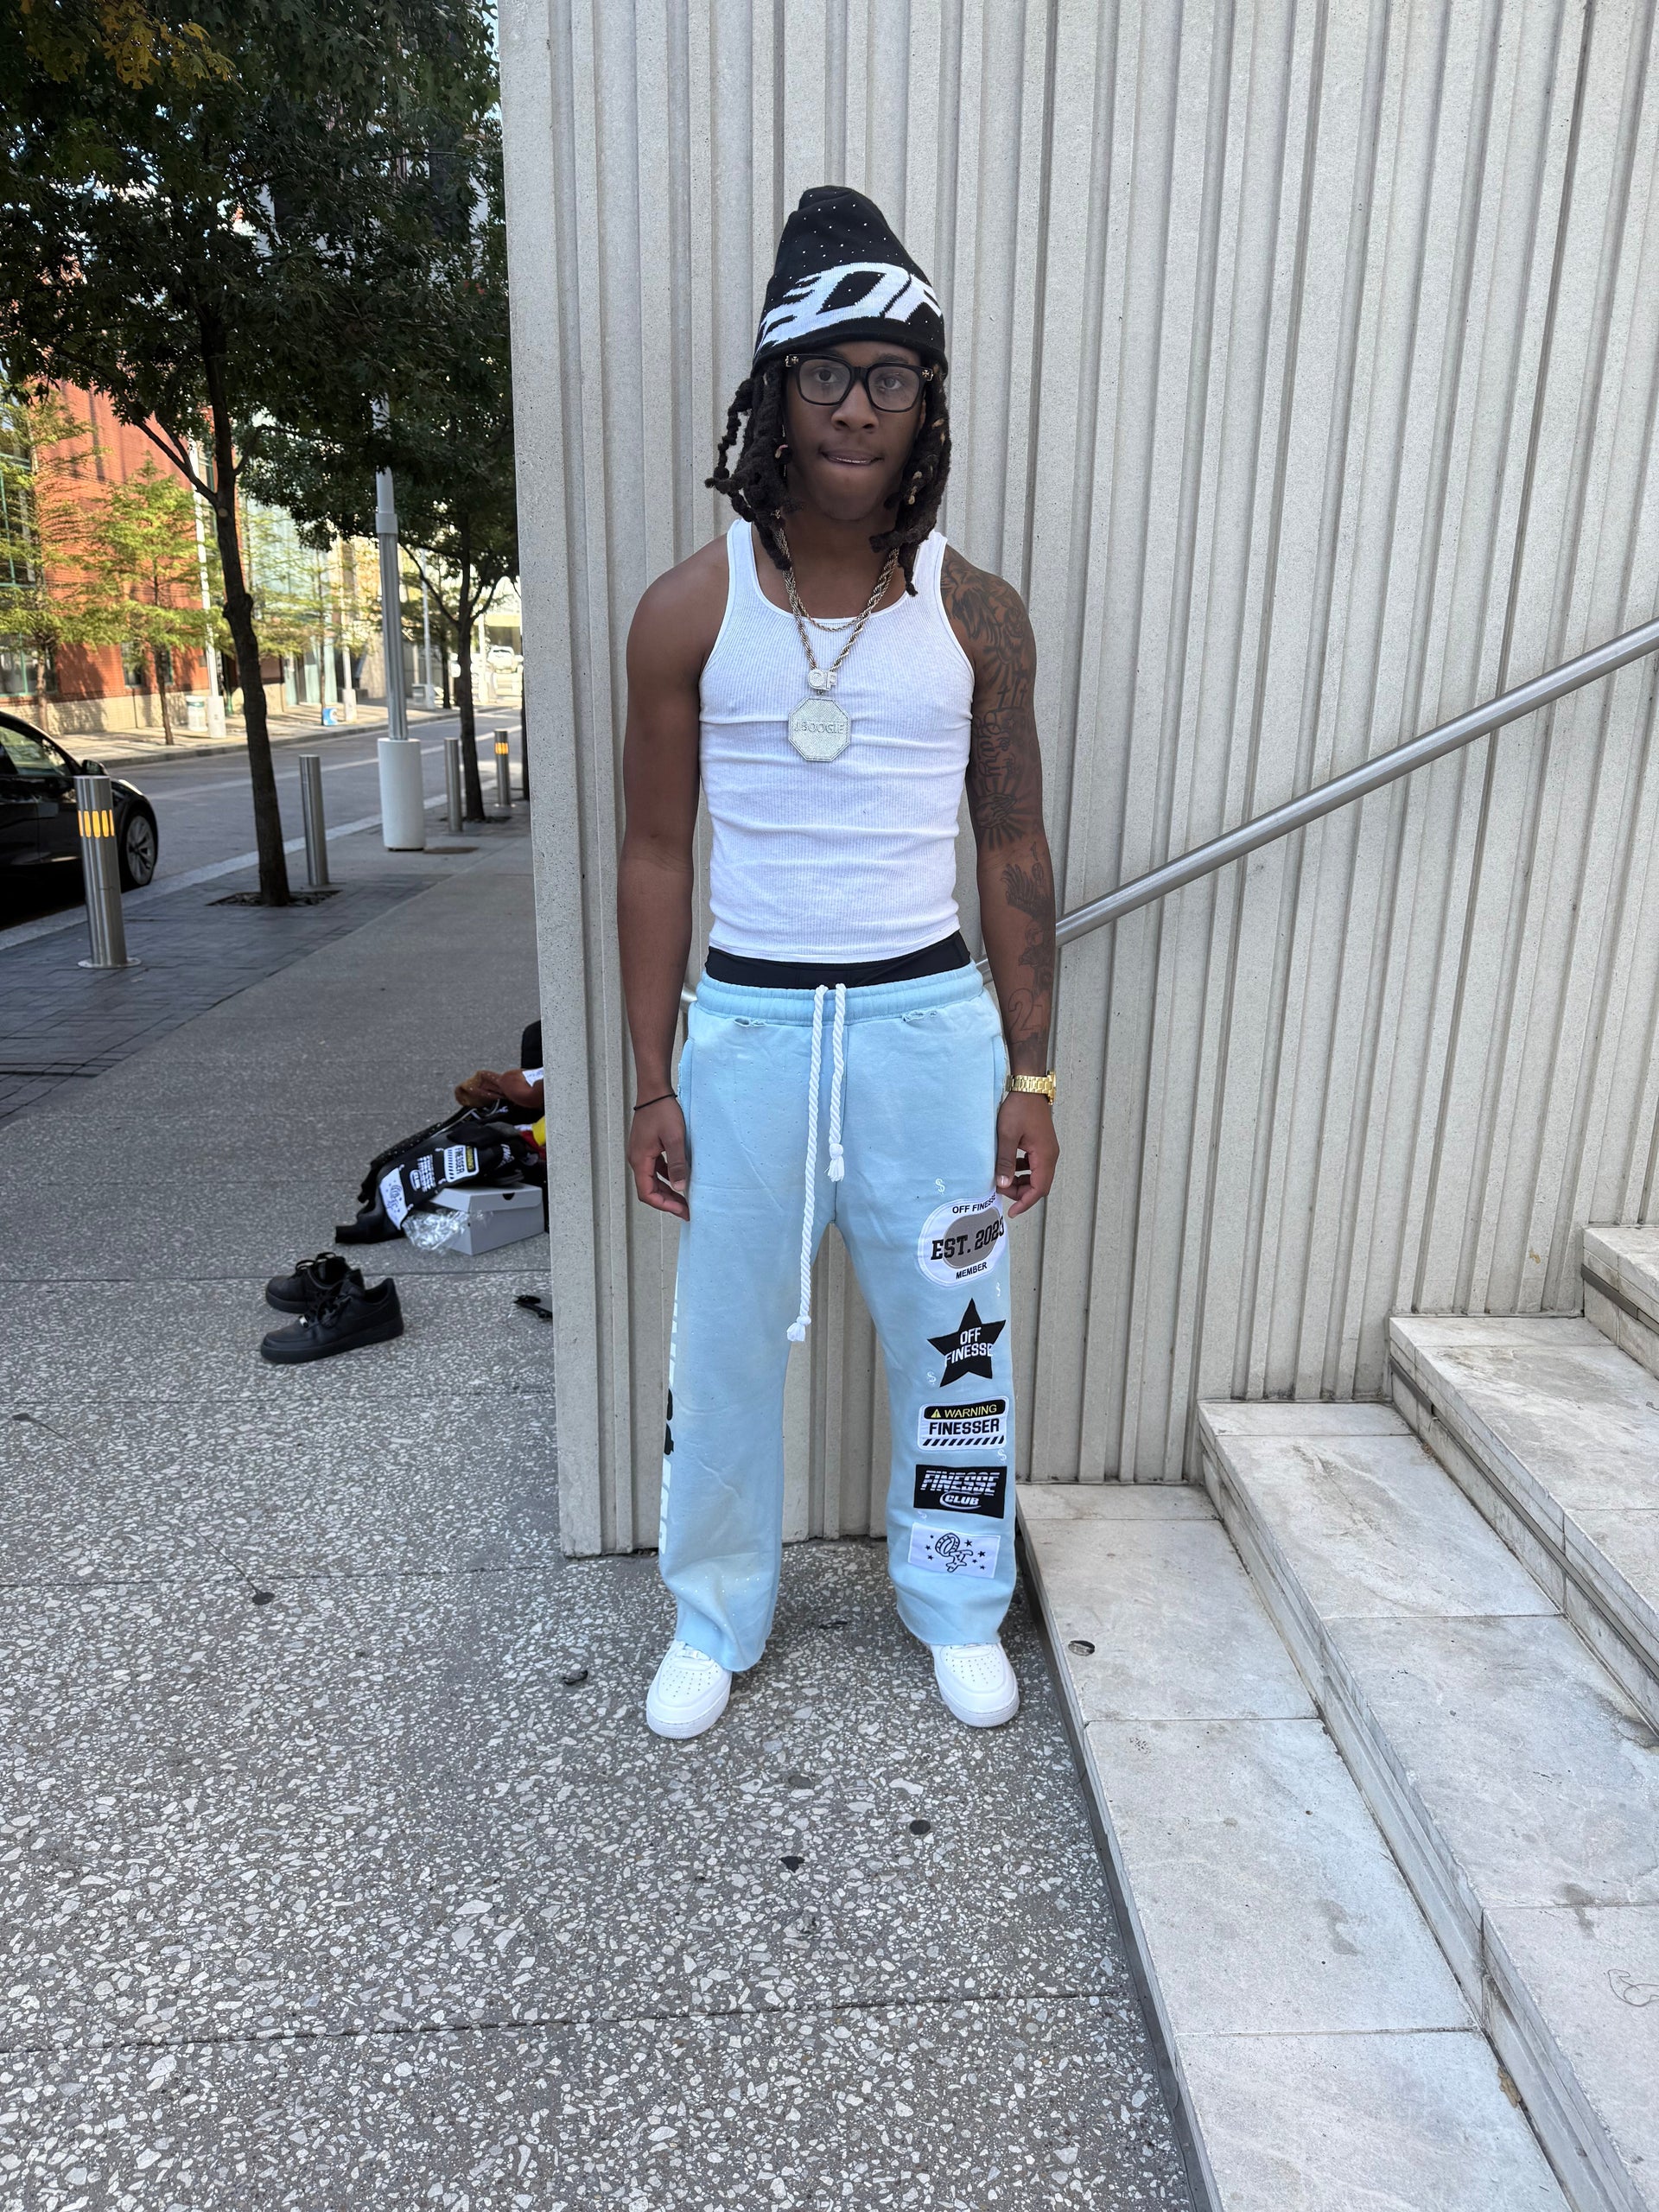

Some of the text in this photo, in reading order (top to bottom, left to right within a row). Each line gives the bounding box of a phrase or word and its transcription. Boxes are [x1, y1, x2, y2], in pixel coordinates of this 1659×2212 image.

[952, 1205, 970, 1214] OFF
[931, 1234, 971, 1261] EST.
[956, 1262, 988, 1280] MEMBER
[960, 1326, 982, 1345] OFF
[944, 1404, 997, 1418] WARNING
[929, 1418, 1000, 1435] FINESSER
[944, 1495, 980, 1506] CLUB
